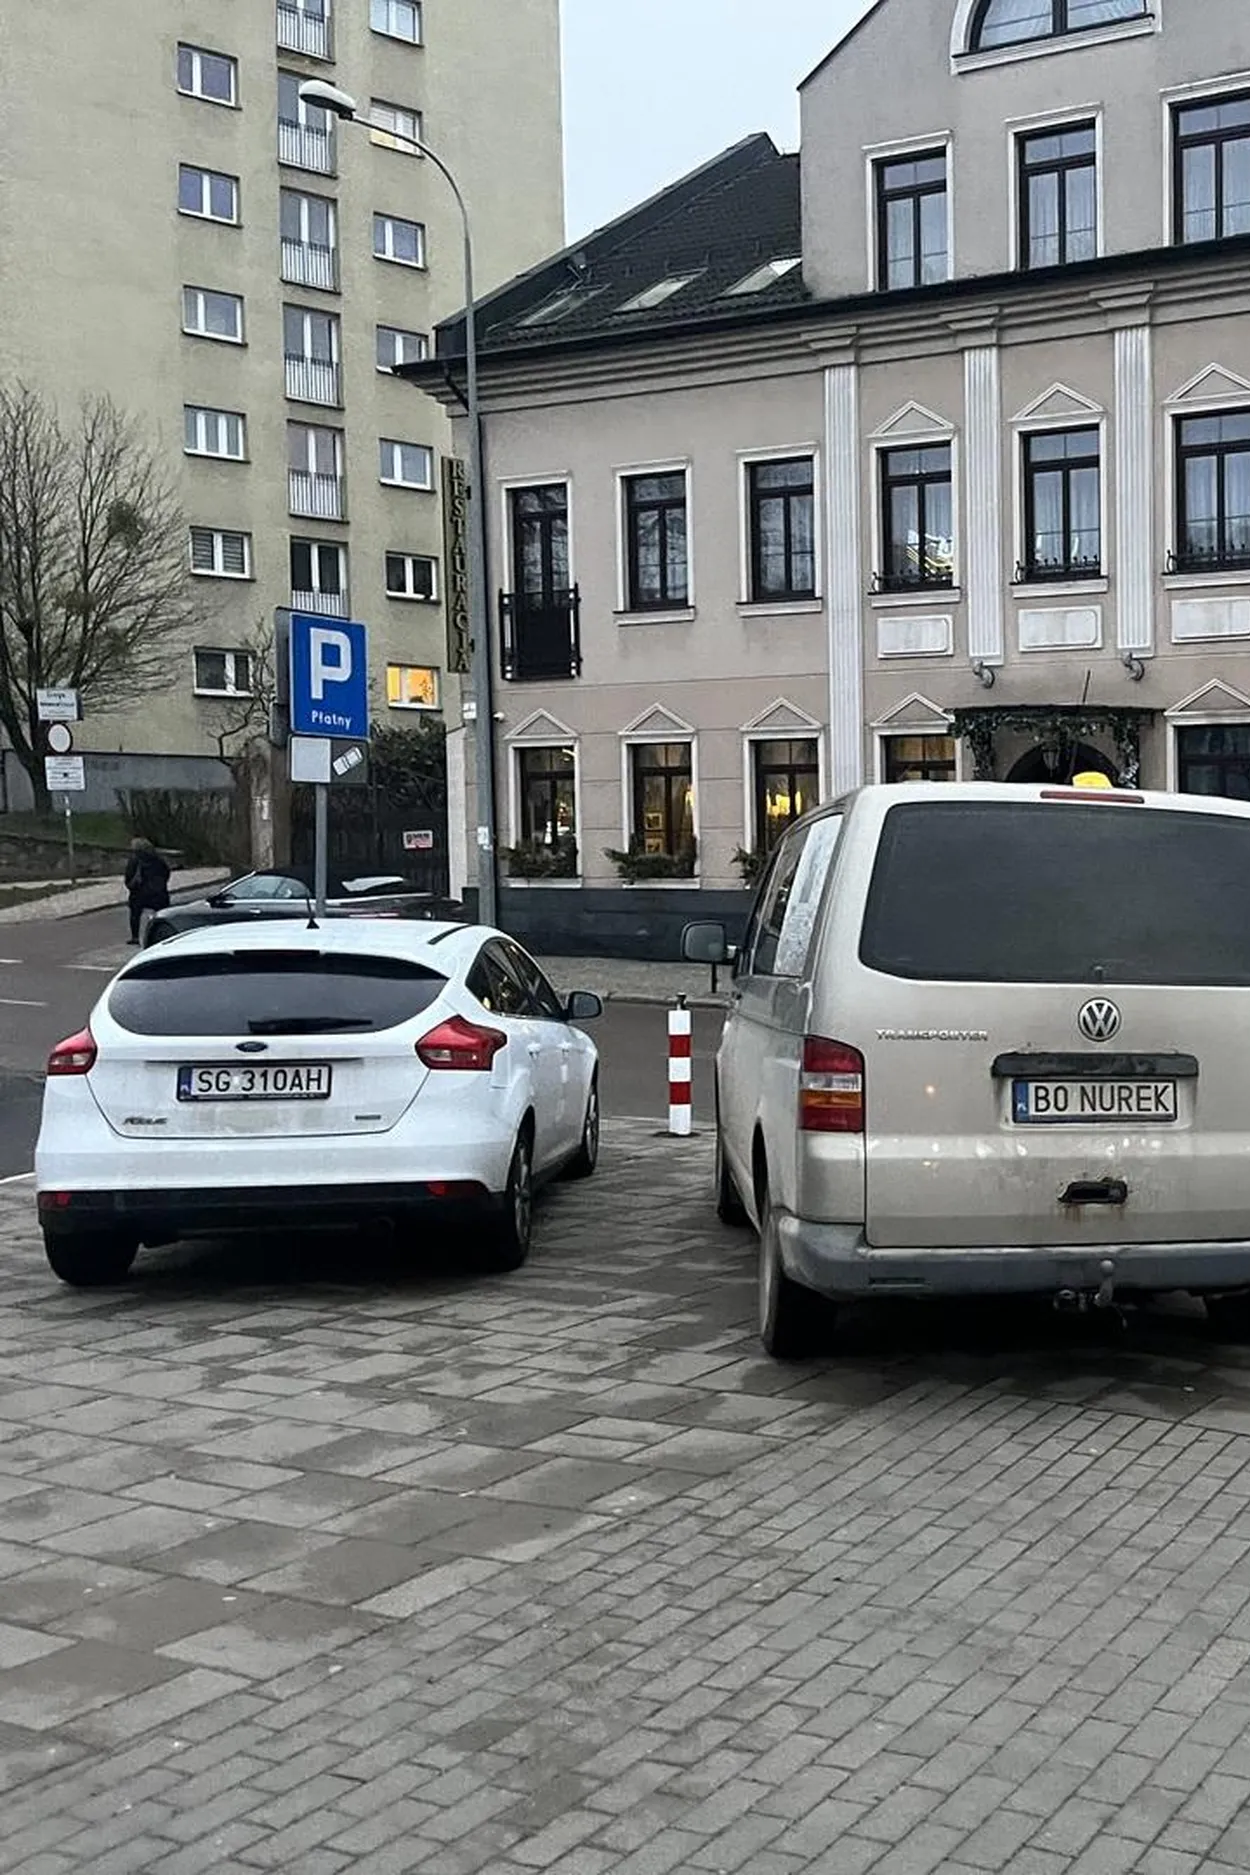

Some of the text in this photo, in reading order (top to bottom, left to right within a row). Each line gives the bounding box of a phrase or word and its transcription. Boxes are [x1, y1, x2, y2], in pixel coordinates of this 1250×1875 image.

[310, 627, 352, 699] P
[311, 710, 352, 731] Płatny
[1080, 1084, 1169, 1112] NUREK
